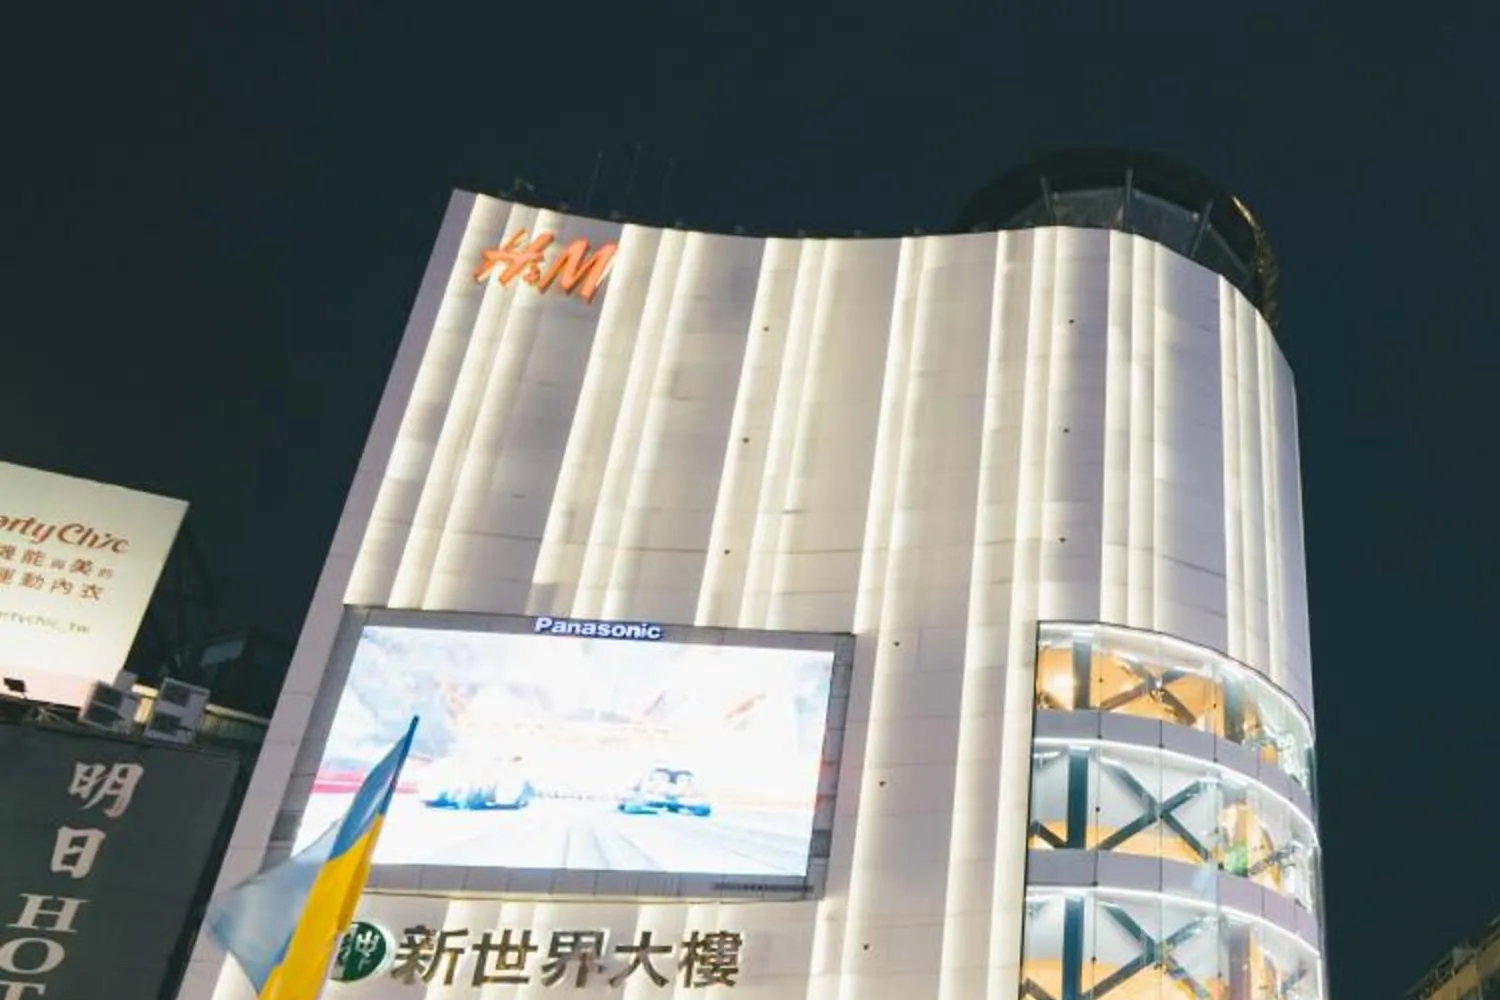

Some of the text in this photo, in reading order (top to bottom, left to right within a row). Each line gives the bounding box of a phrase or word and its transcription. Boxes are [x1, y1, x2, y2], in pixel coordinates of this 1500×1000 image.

[474, 207, 620, 305] H&M
[535, 616, 662, 640] Panasonic
[50, 761, 144, 880] 明日
[391, 924, 743, 989] 新世界大樓
